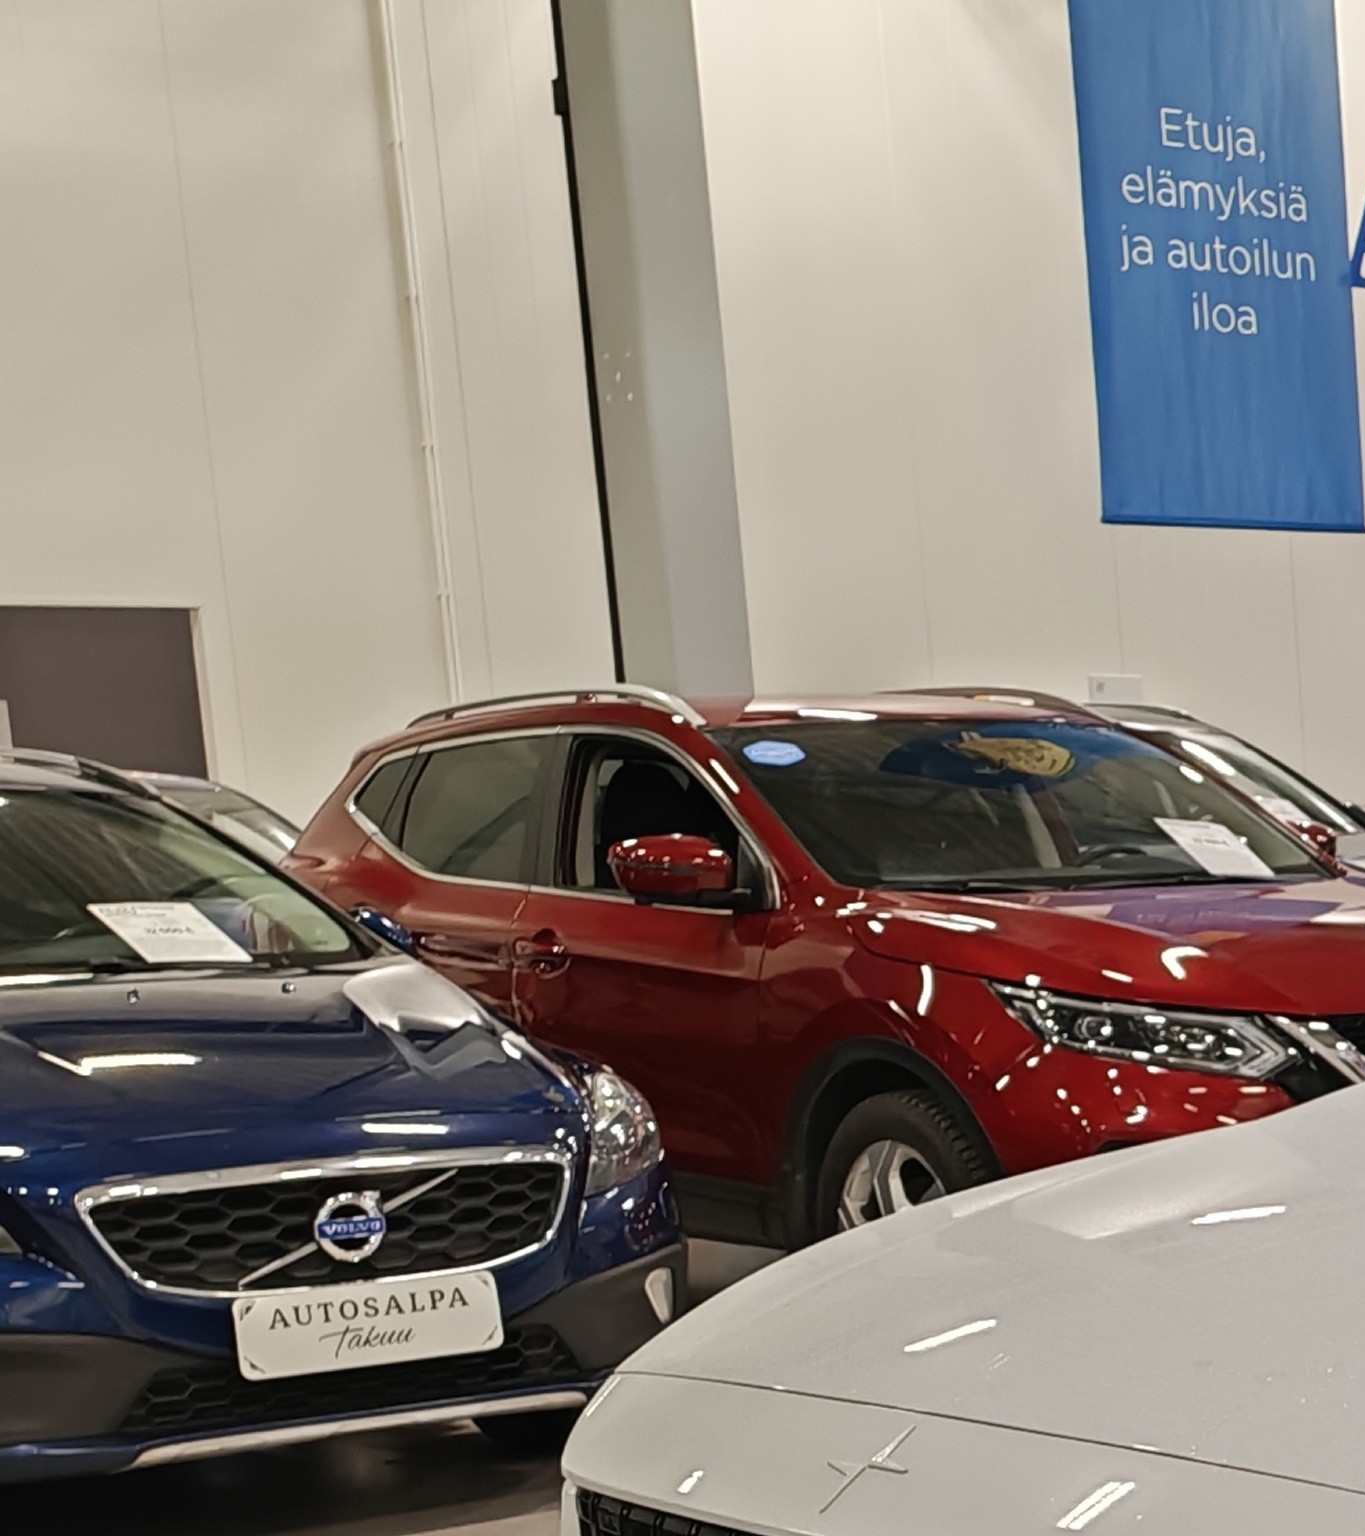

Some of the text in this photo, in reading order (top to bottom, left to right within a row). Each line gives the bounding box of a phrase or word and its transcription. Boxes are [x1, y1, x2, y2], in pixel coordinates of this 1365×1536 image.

[1159, 106, 1268, 164] Etuja,
[1120, 165, 1309, 223] elämyksiä
[1119, 223, 1317, 282] ja autoilun
[1191, 291, 1259, 335] iloa
[320, 1219, 382, 1237] VOLVO
[268, 1286, 470, 1331] AUTOSALPA
[318, 1324, 417, 1360] Takuu
